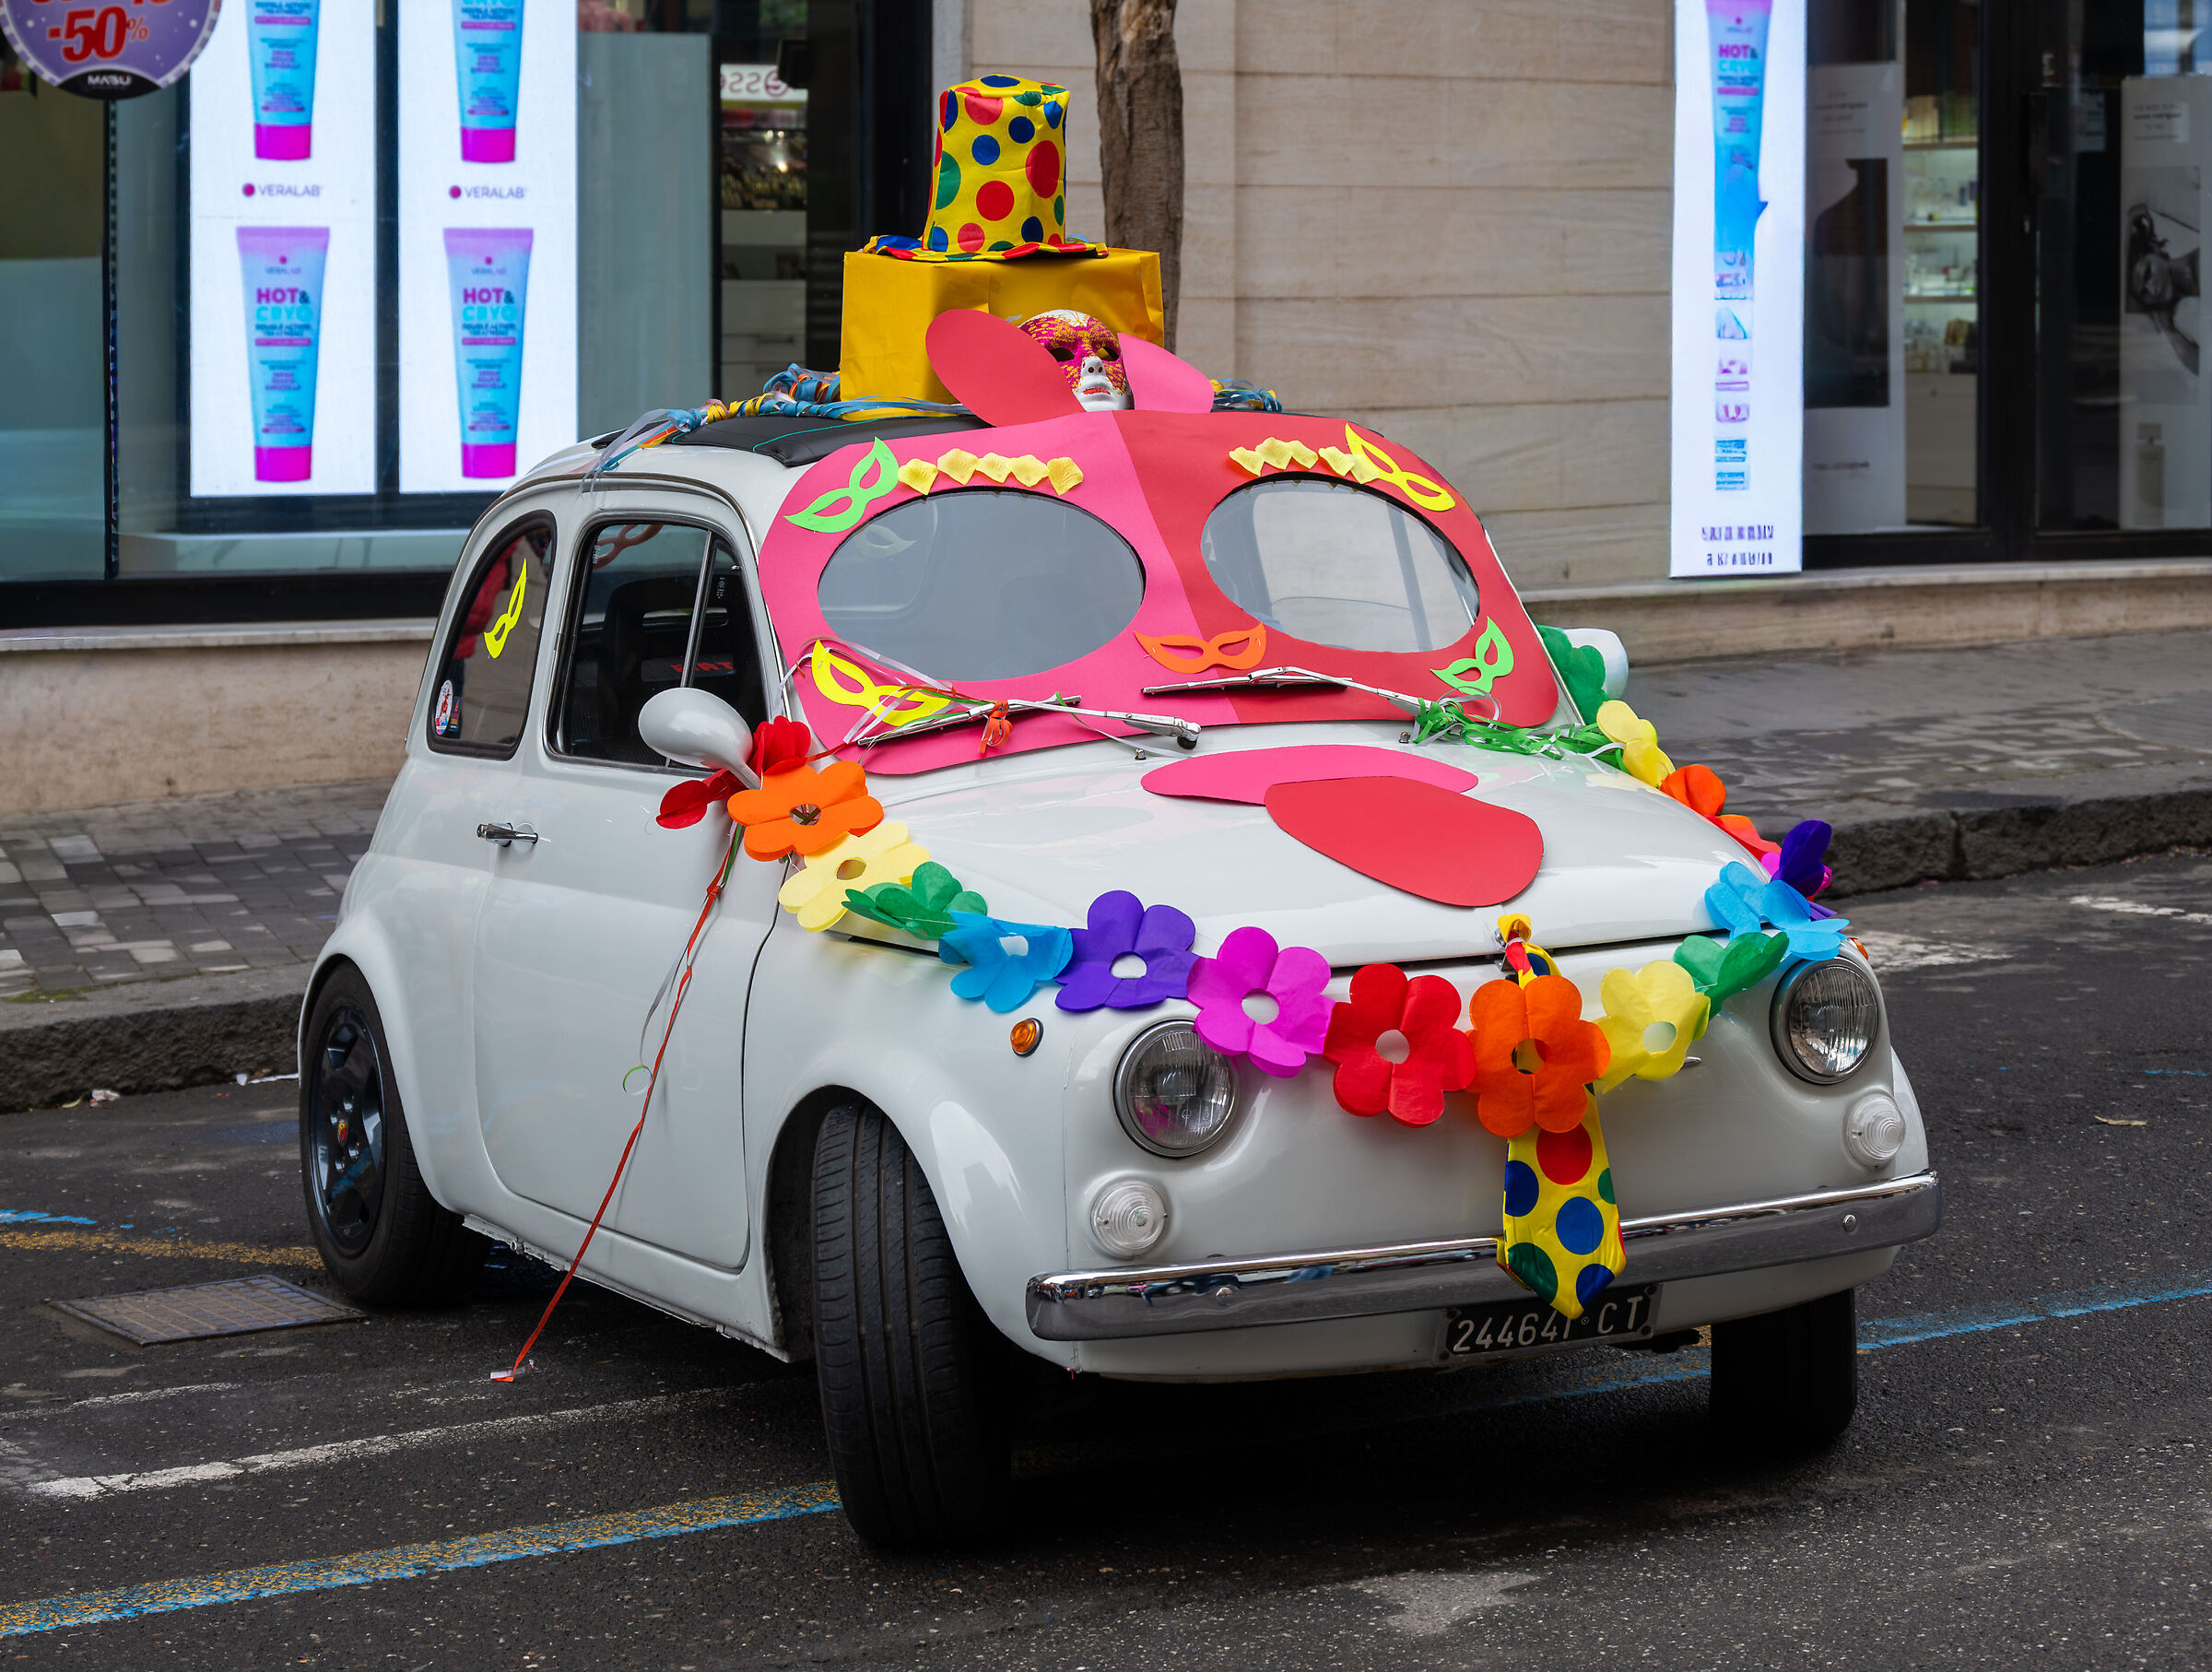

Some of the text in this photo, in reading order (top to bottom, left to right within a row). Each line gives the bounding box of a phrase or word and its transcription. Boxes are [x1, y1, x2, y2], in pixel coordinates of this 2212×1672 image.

[48, 6, 148, 63] -50%
[258, 184, 321, 197] VERALAB
[465, 186, 524, 199] VERALAB
[670, 662, 735, 673] FAT
